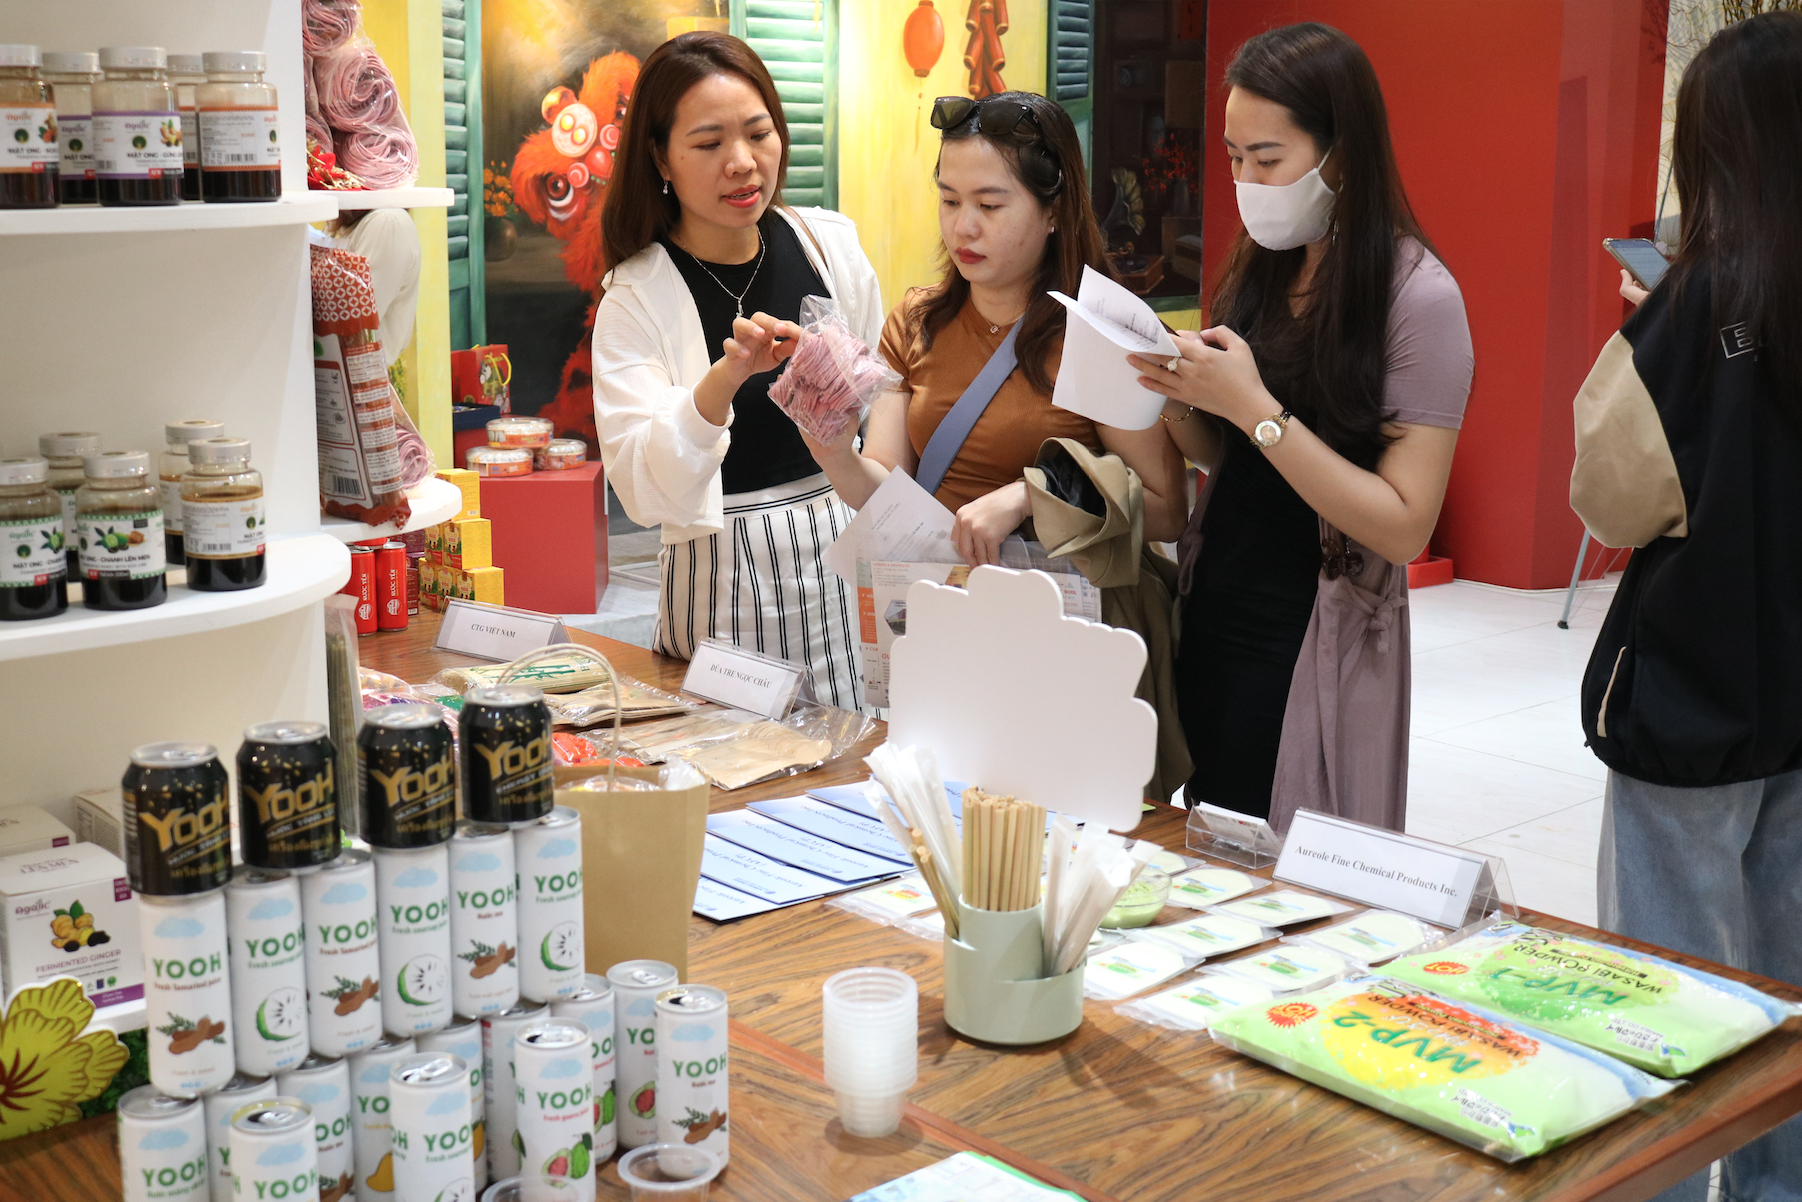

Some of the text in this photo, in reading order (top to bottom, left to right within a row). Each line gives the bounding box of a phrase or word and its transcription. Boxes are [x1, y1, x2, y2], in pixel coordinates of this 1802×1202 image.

[471, 624, 485, 632] CTG
[500, 629, 516, 638] NAM
[724, 668, 736, 678] TRE
[1295, 845, 1458, 897] Aureole Fine Chemical Products Inc.
[457, 883, 514, 909] YOOH
[390, 896, 448, 924] YOOH
[318, 915, 377, 944] YOOH
[36, 956, 89, 974] FERMENTED
[90, 950, 122, 964] GINGER
[153, 952, 222, 979] YOOH
[1426, 963, 1466, 975] HOT
[1513, 944, 1663, 995] WASABI POWDER
[1487, 973, 1627, 1005] MVP-1
[1270, 1004, 1316, 1019] HOT
[626, 1028, 655, 1045] YO
[1367, 993, 1521, 1058] WASABI POWDER
[1332, 1009, 1482, 1076] MVP-2
[672, 1052, 727, 1078] YOOH
[358, 1095, 391, 1114] YO
[537, 1082, 592, 1110] YOOH
[142, 1153, 206, 1188] YOOH
[254, 1166, 319, 1200] YOOH
